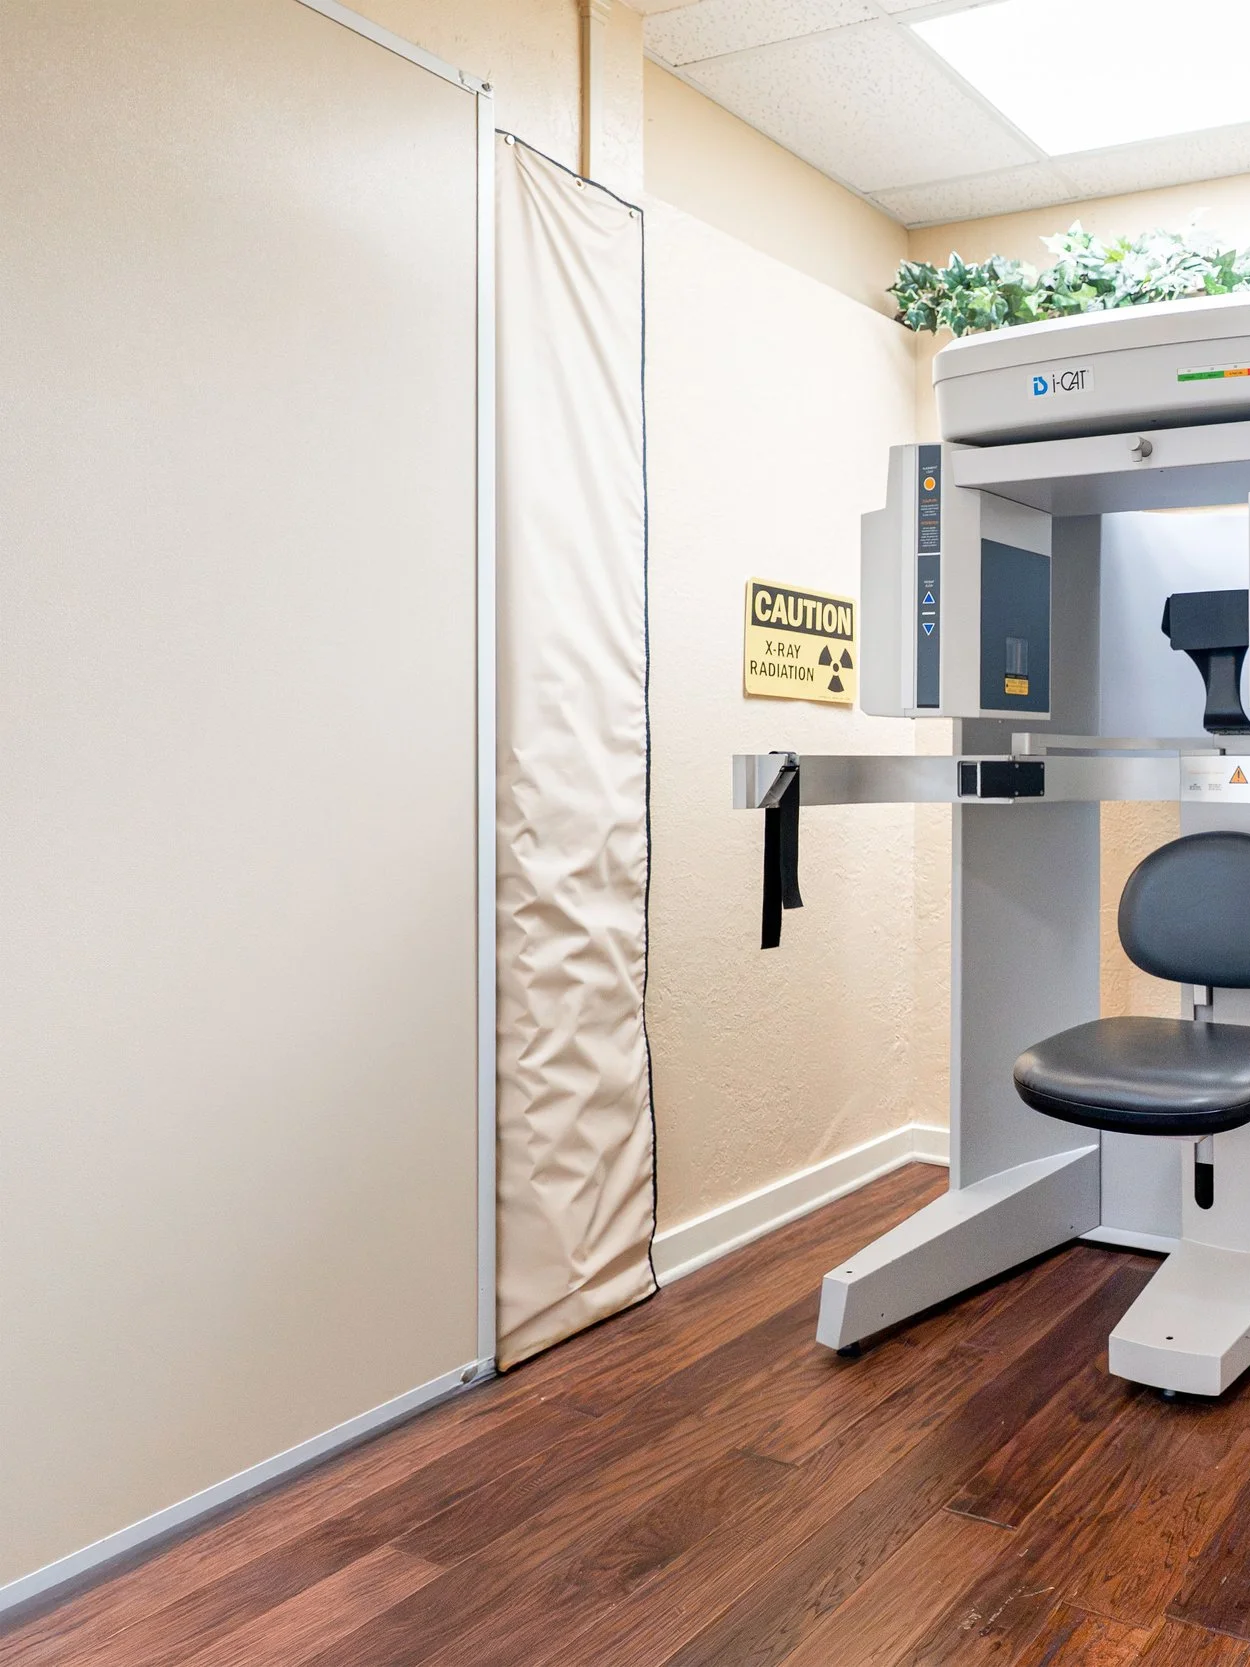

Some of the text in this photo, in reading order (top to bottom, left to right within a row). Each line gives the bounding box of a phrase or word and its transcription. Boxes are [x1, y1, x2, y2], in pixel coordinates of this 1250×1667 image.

[1052, 369, 1087, 393] i-CAT
[754, 590, 852, 636] CAUTION
[765, 640, 801, 659] X-RAY
[750, 660, 814, 682] RADIATION
